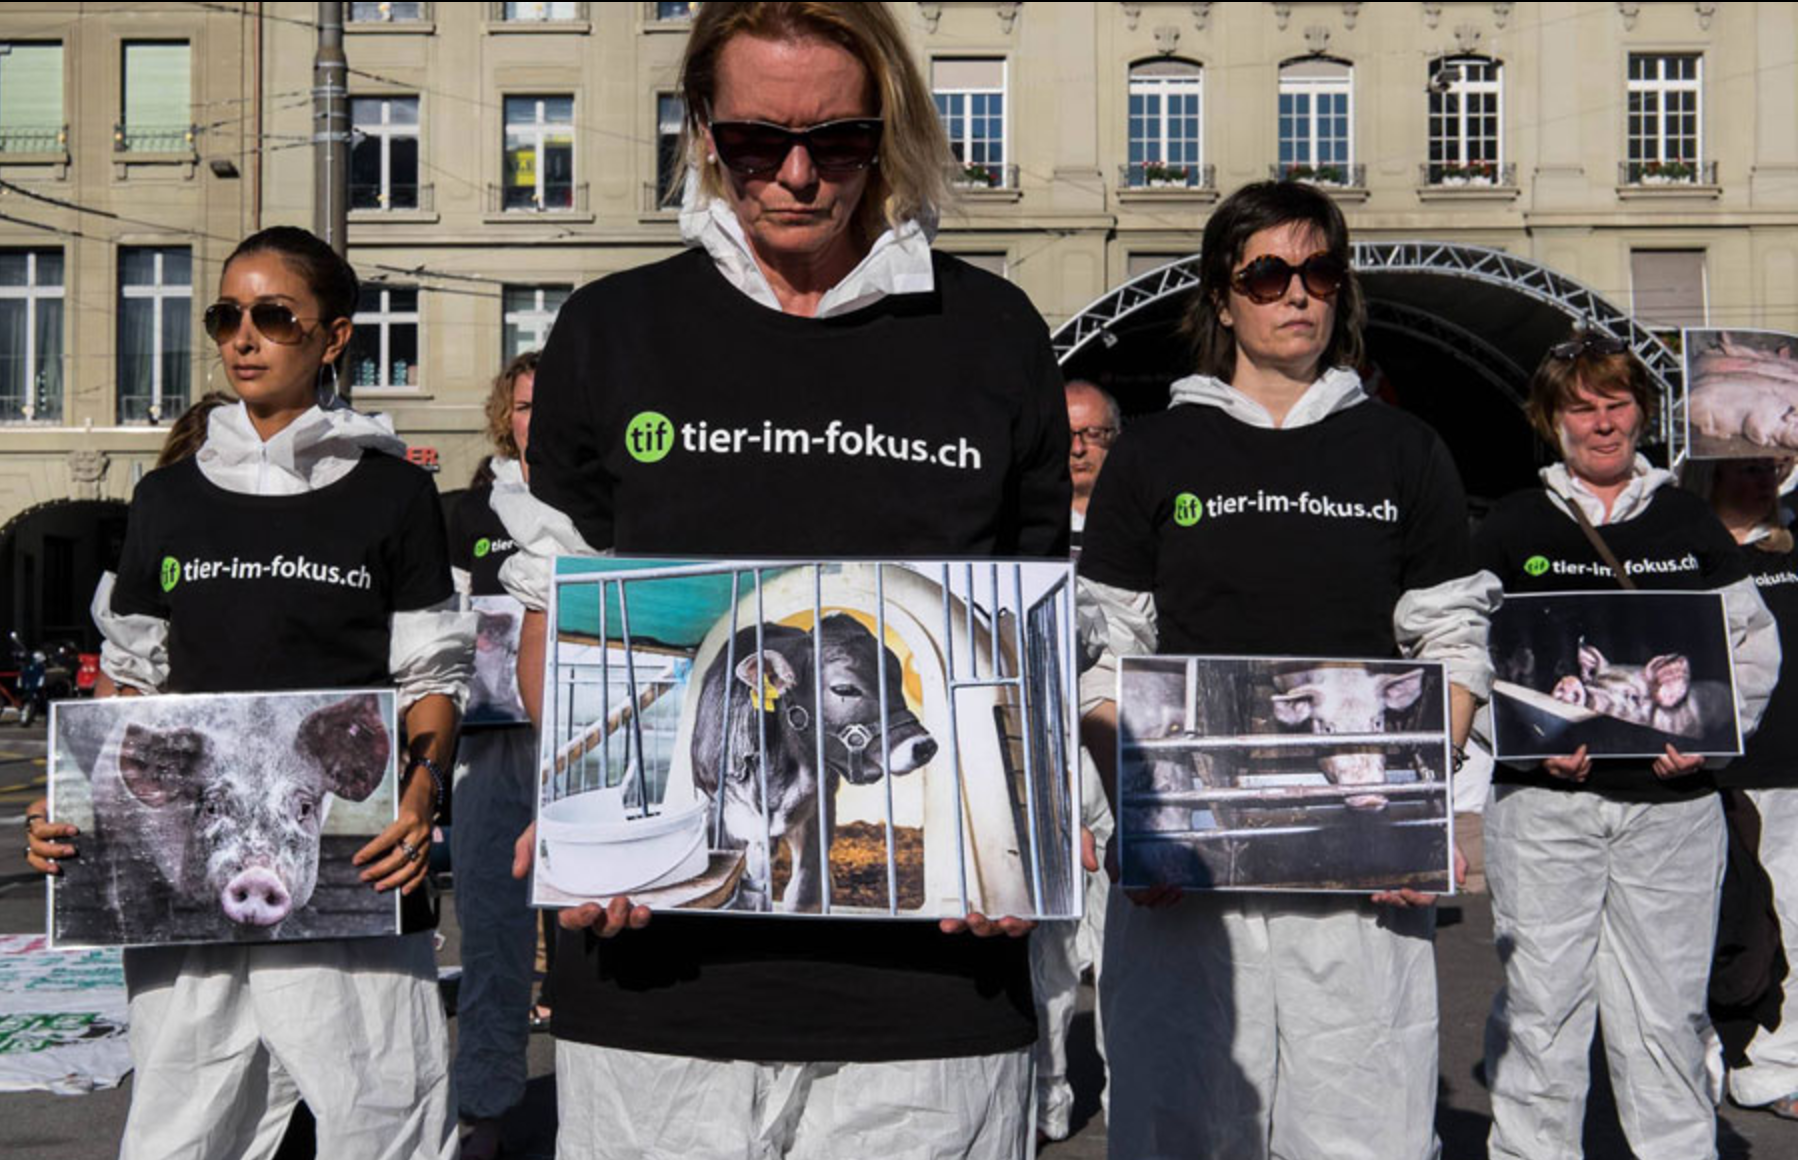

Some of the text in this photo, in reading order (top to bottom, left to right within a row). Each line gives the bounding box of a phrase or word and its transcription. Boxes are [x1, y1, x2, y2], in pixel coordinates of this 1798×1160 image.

[629, 419, 982, 469] tif tier-im-fokus.ch
[1206, 490, 1398, 522] tier-im-fokus.ch
[183, 555, 371, 589] tier-im-fokus.ch
[1552, 553, 1698, 577] tier-imfokus.ch
